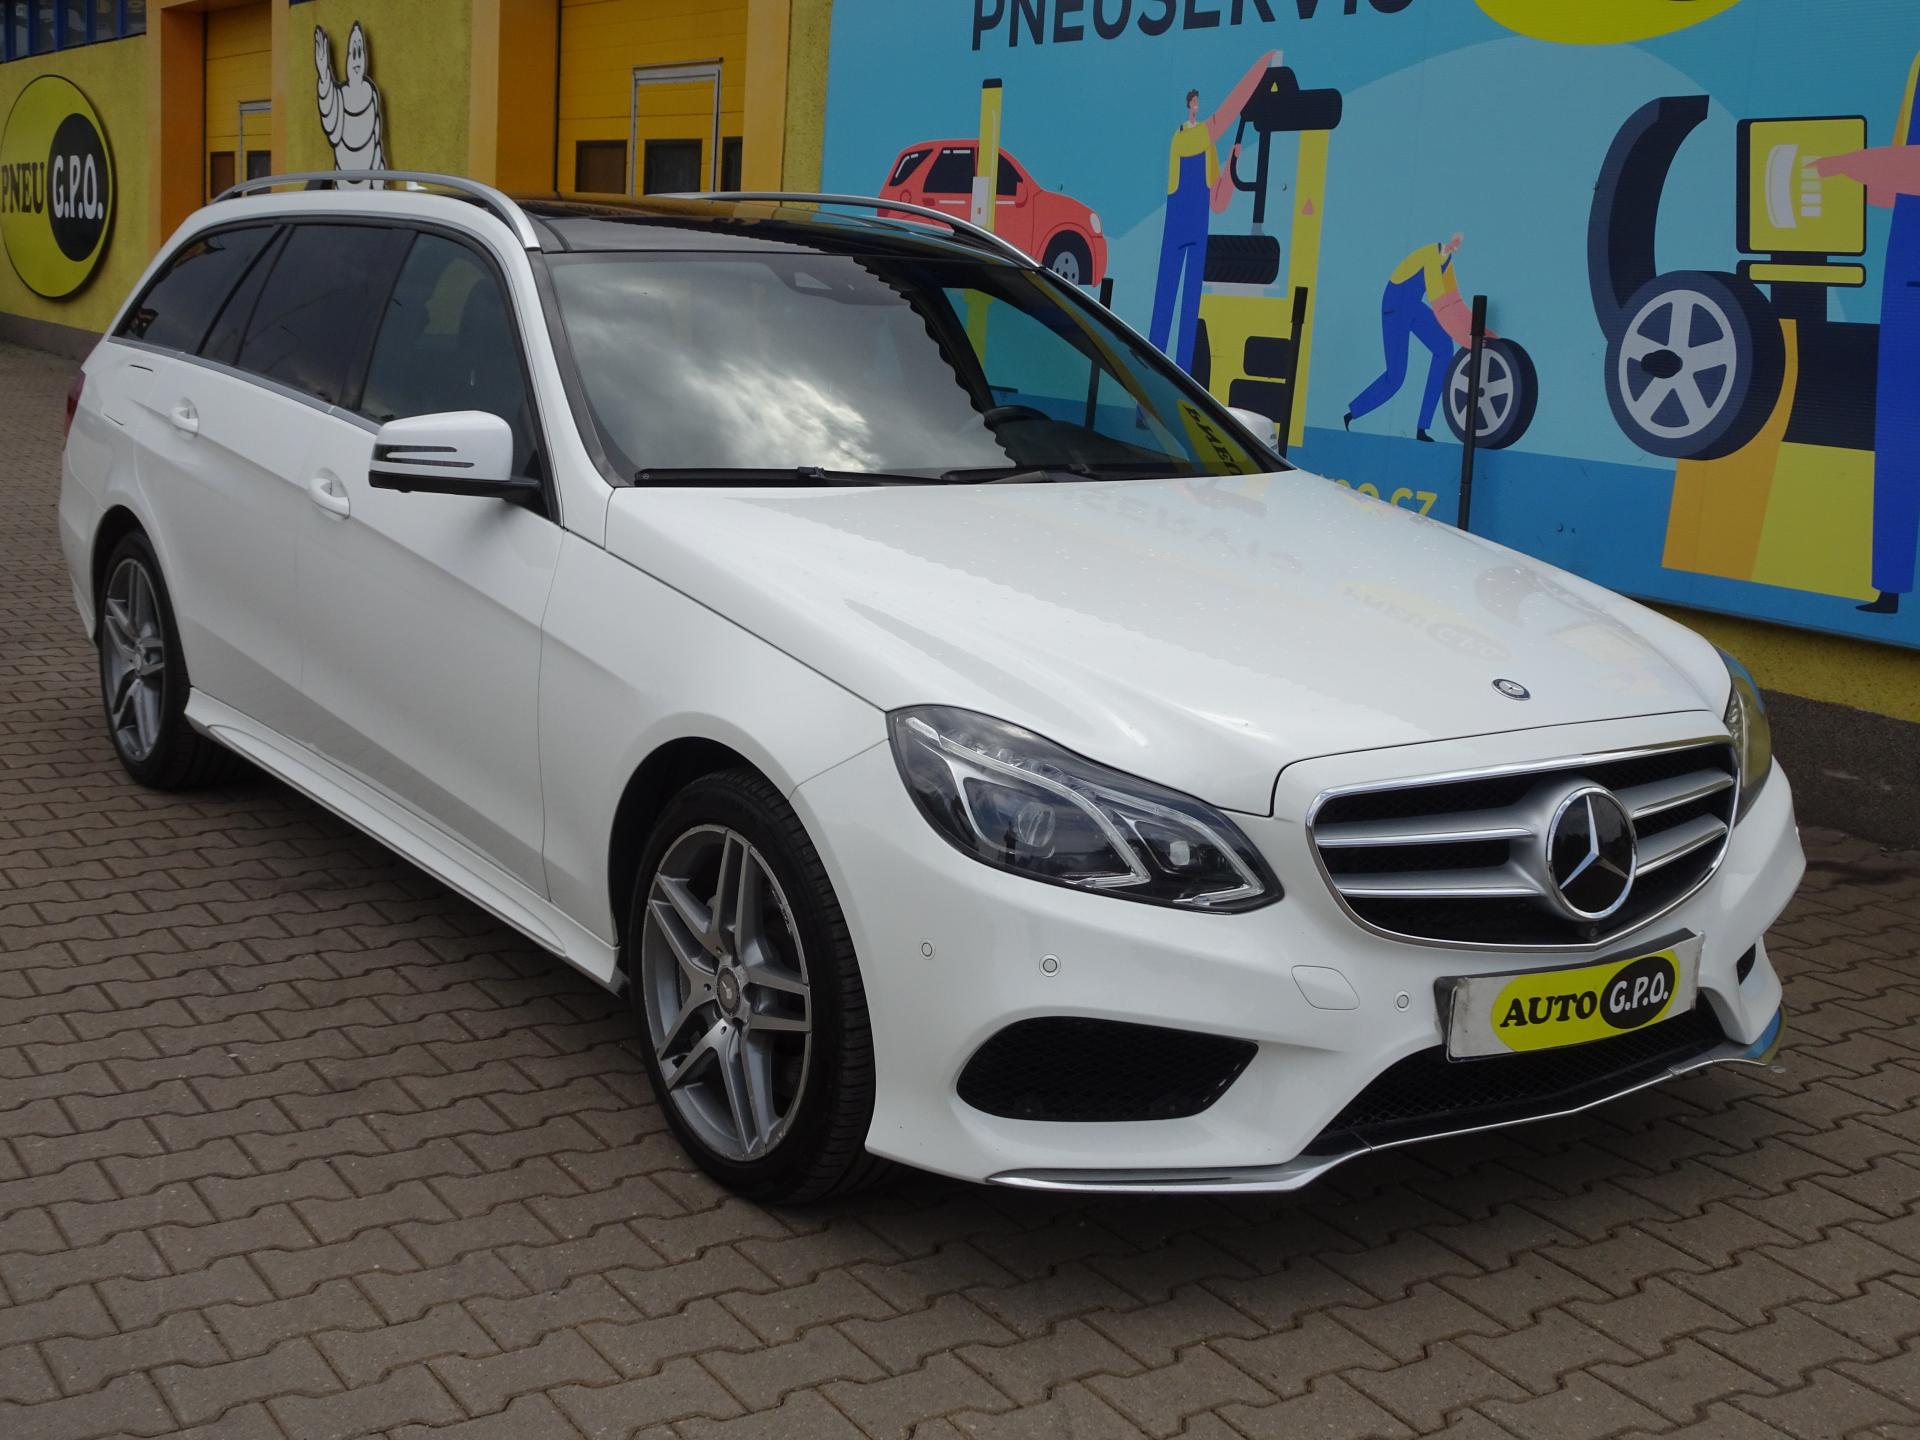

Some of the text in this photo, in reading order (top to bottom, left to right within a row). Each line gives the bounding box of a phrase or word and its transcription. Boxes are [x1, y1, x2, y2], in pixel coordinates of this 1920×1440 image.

[1, 153, 103, 219] PNEU G.P.O.
[1500, 971, 1669, 1028] AUTO G.P.O.
